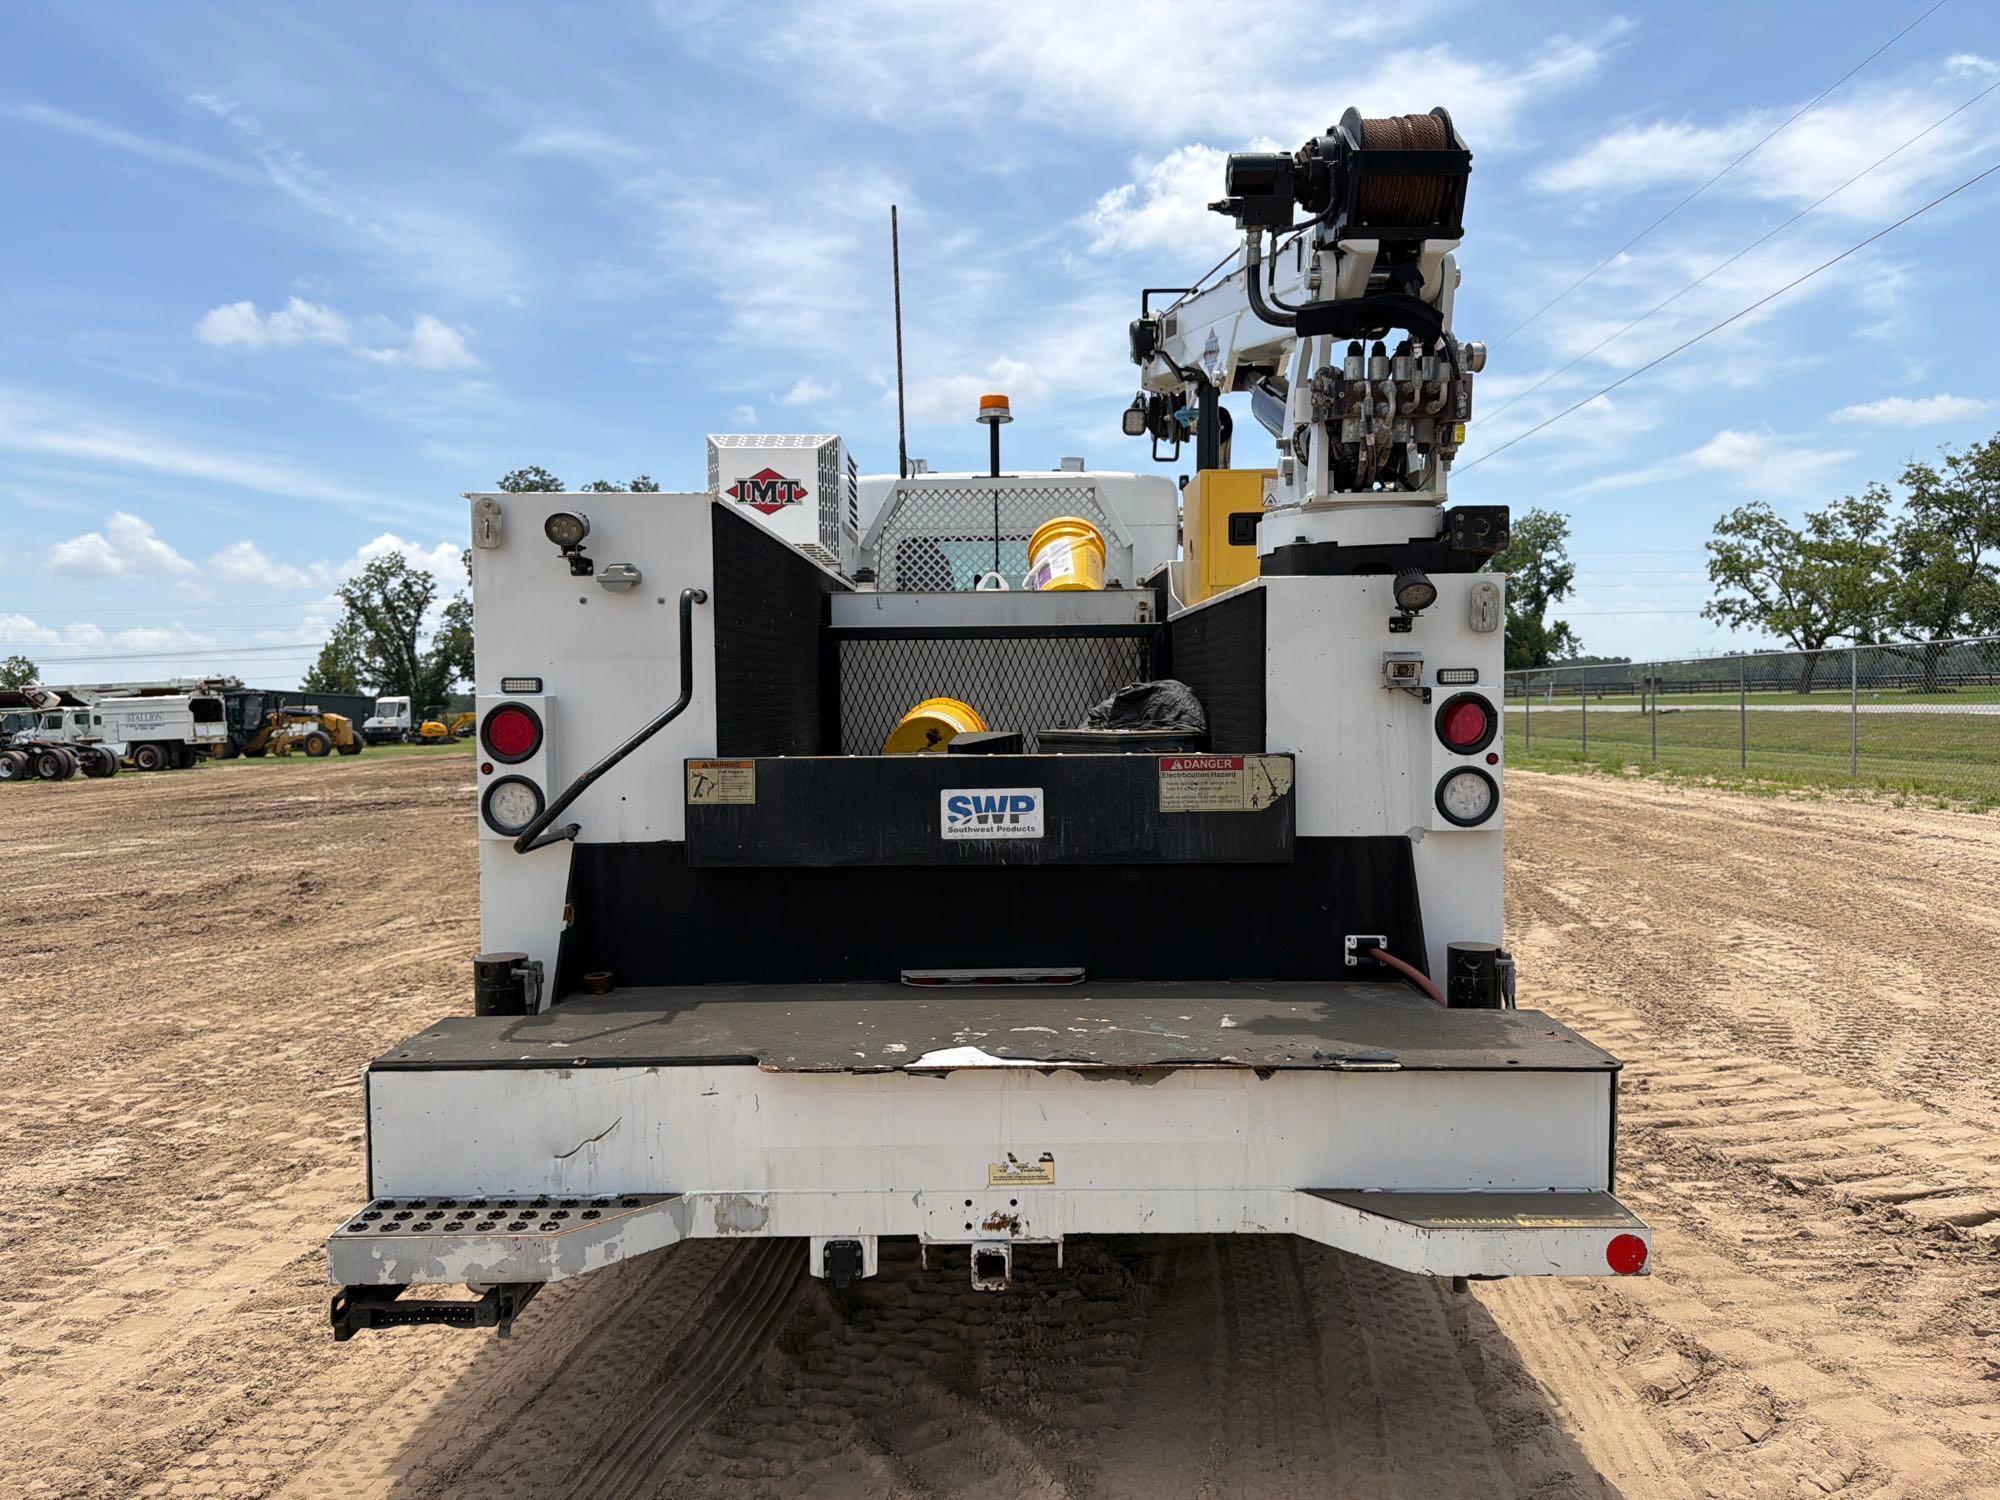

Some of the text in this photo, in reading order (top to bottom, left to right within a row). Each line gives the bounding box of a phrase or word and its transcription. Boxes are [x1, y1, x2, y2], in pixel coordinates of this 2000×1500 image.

[736, 479, 800, 504] IMT
[1183, 759, 1232, 769] DANGER
[947, 795, 1036, 825] SWP
[997, 825, 1036, 833] Products
